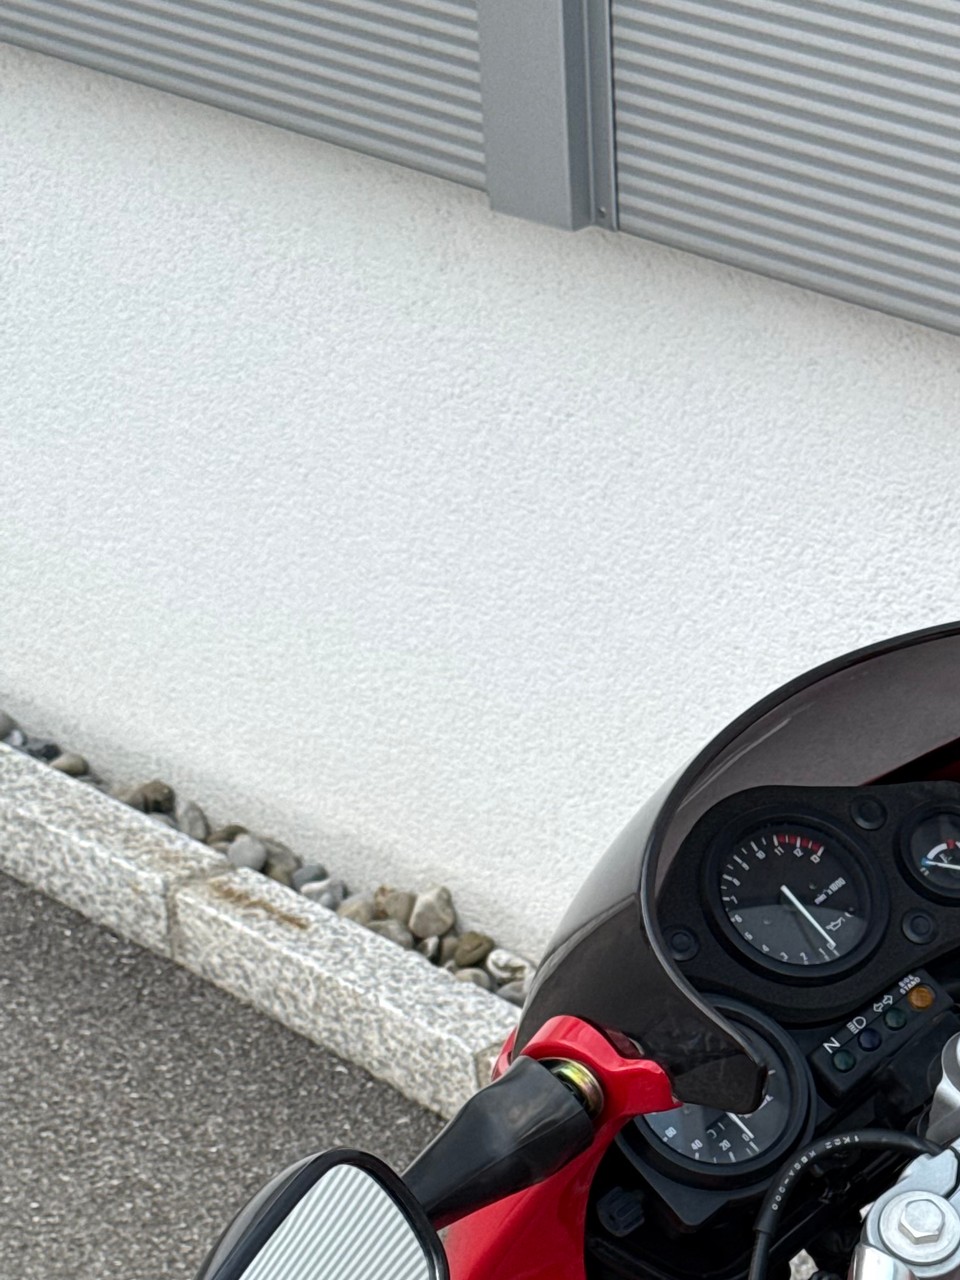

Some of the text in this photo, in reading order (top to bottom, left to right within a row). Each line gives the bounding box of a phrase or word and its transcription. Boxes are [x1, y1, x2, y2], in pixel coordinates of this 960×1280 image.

[756, 850, 766, 860] 10
[774, 846, 784, 856] 11
[793, 848, 803, 857] 12
[731, 895, 738, 904] 7
[734, 914, 743, 923] 6
[744, 931, 753, 941] 5
[780, 952, 788, 961] 3
[800, 952, 808, 961] 2
[899, 976, 921, 995] STAND
[823, 1037, 841, 1054] N
[741, 1133, 750, 1142] 0
[691, 1139, 703, 1150] 40
[719, 1139, 731, 1151] 20
